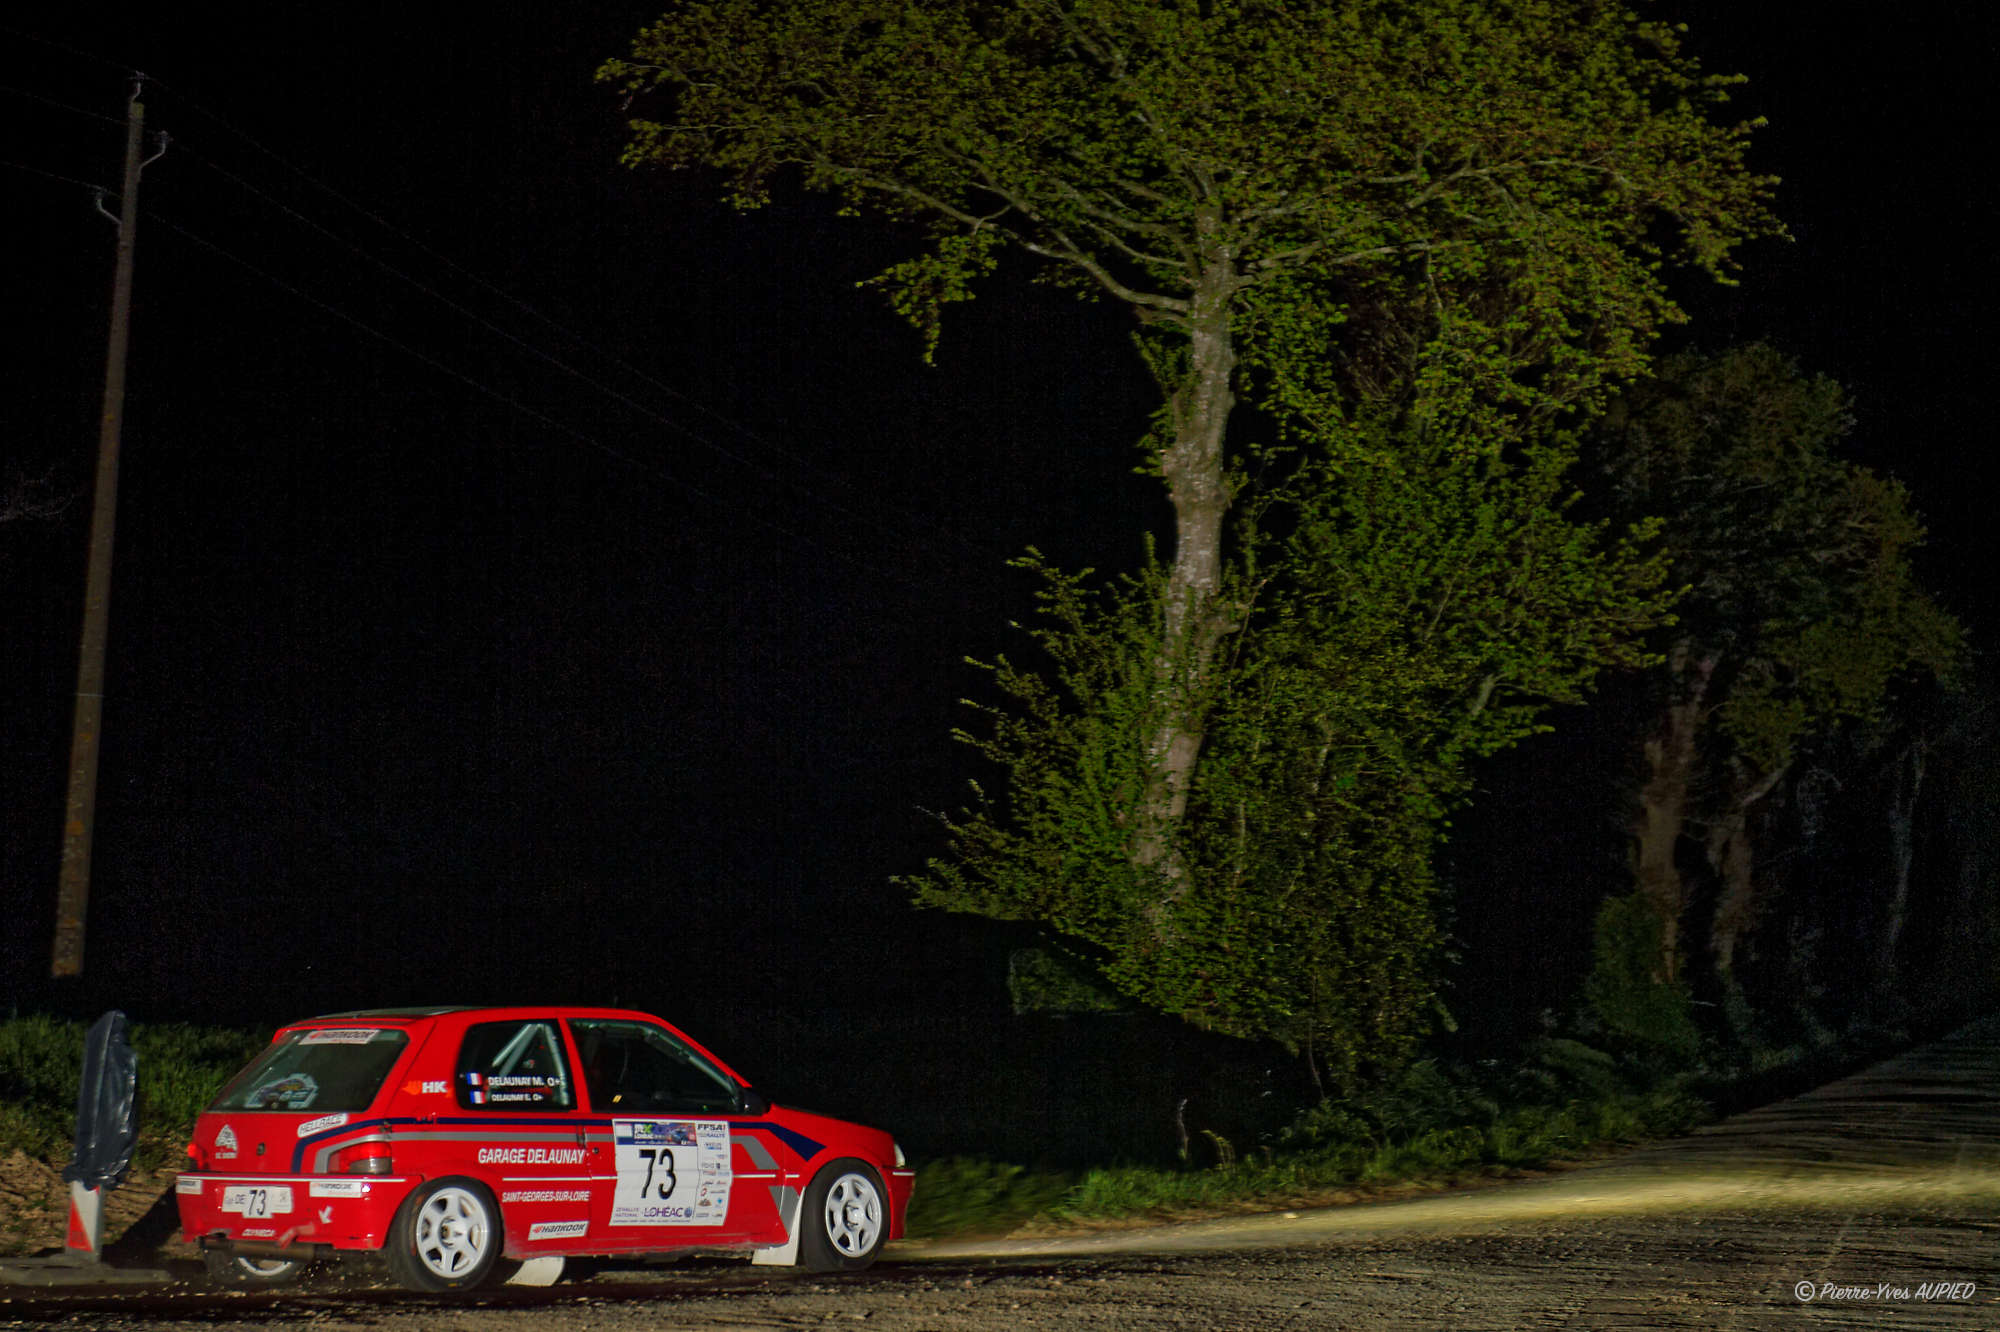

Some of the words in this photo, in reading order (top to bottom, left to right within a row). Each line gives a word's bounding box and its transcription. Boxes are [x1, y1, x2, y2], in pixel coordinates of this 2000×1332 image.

[422, 1081, 447, 1093] HK
[488, 1076, 531, 1086] DELAUNAY
[478, 1148, 525, 1164] GARAGE
[527, 1148, 585, 1164] DELAUNAY
[639, 1148, 676, 1200] 73
[248, 1189, 266, 1216] 73
[502, 1191, 590, 1202] SAINT-GEORGES-SUR-LOIRE
